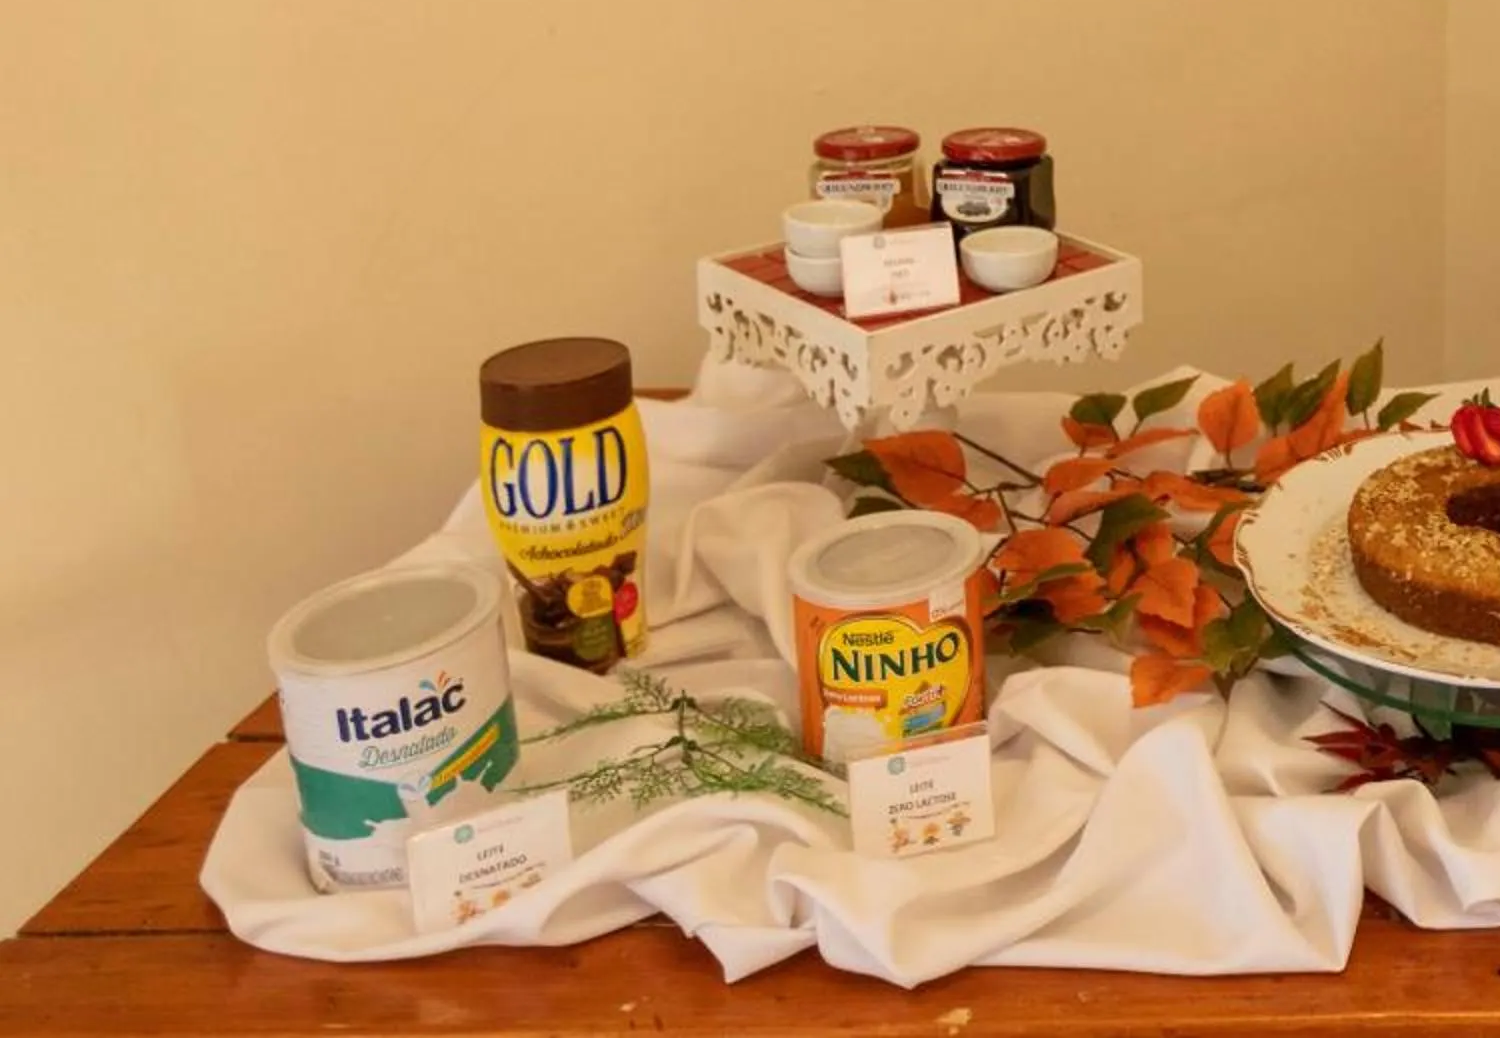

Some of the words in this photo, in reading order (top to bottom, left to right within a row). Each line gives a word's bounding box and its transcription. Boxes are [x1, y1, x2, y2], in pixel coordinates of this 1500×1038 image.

[489, 424, 628, 520] GOLD
[830, 631, 961, 683] NINHO
[335, 681, 467, 743] Italac
[459, 853, 528, 884] DESNATADO
